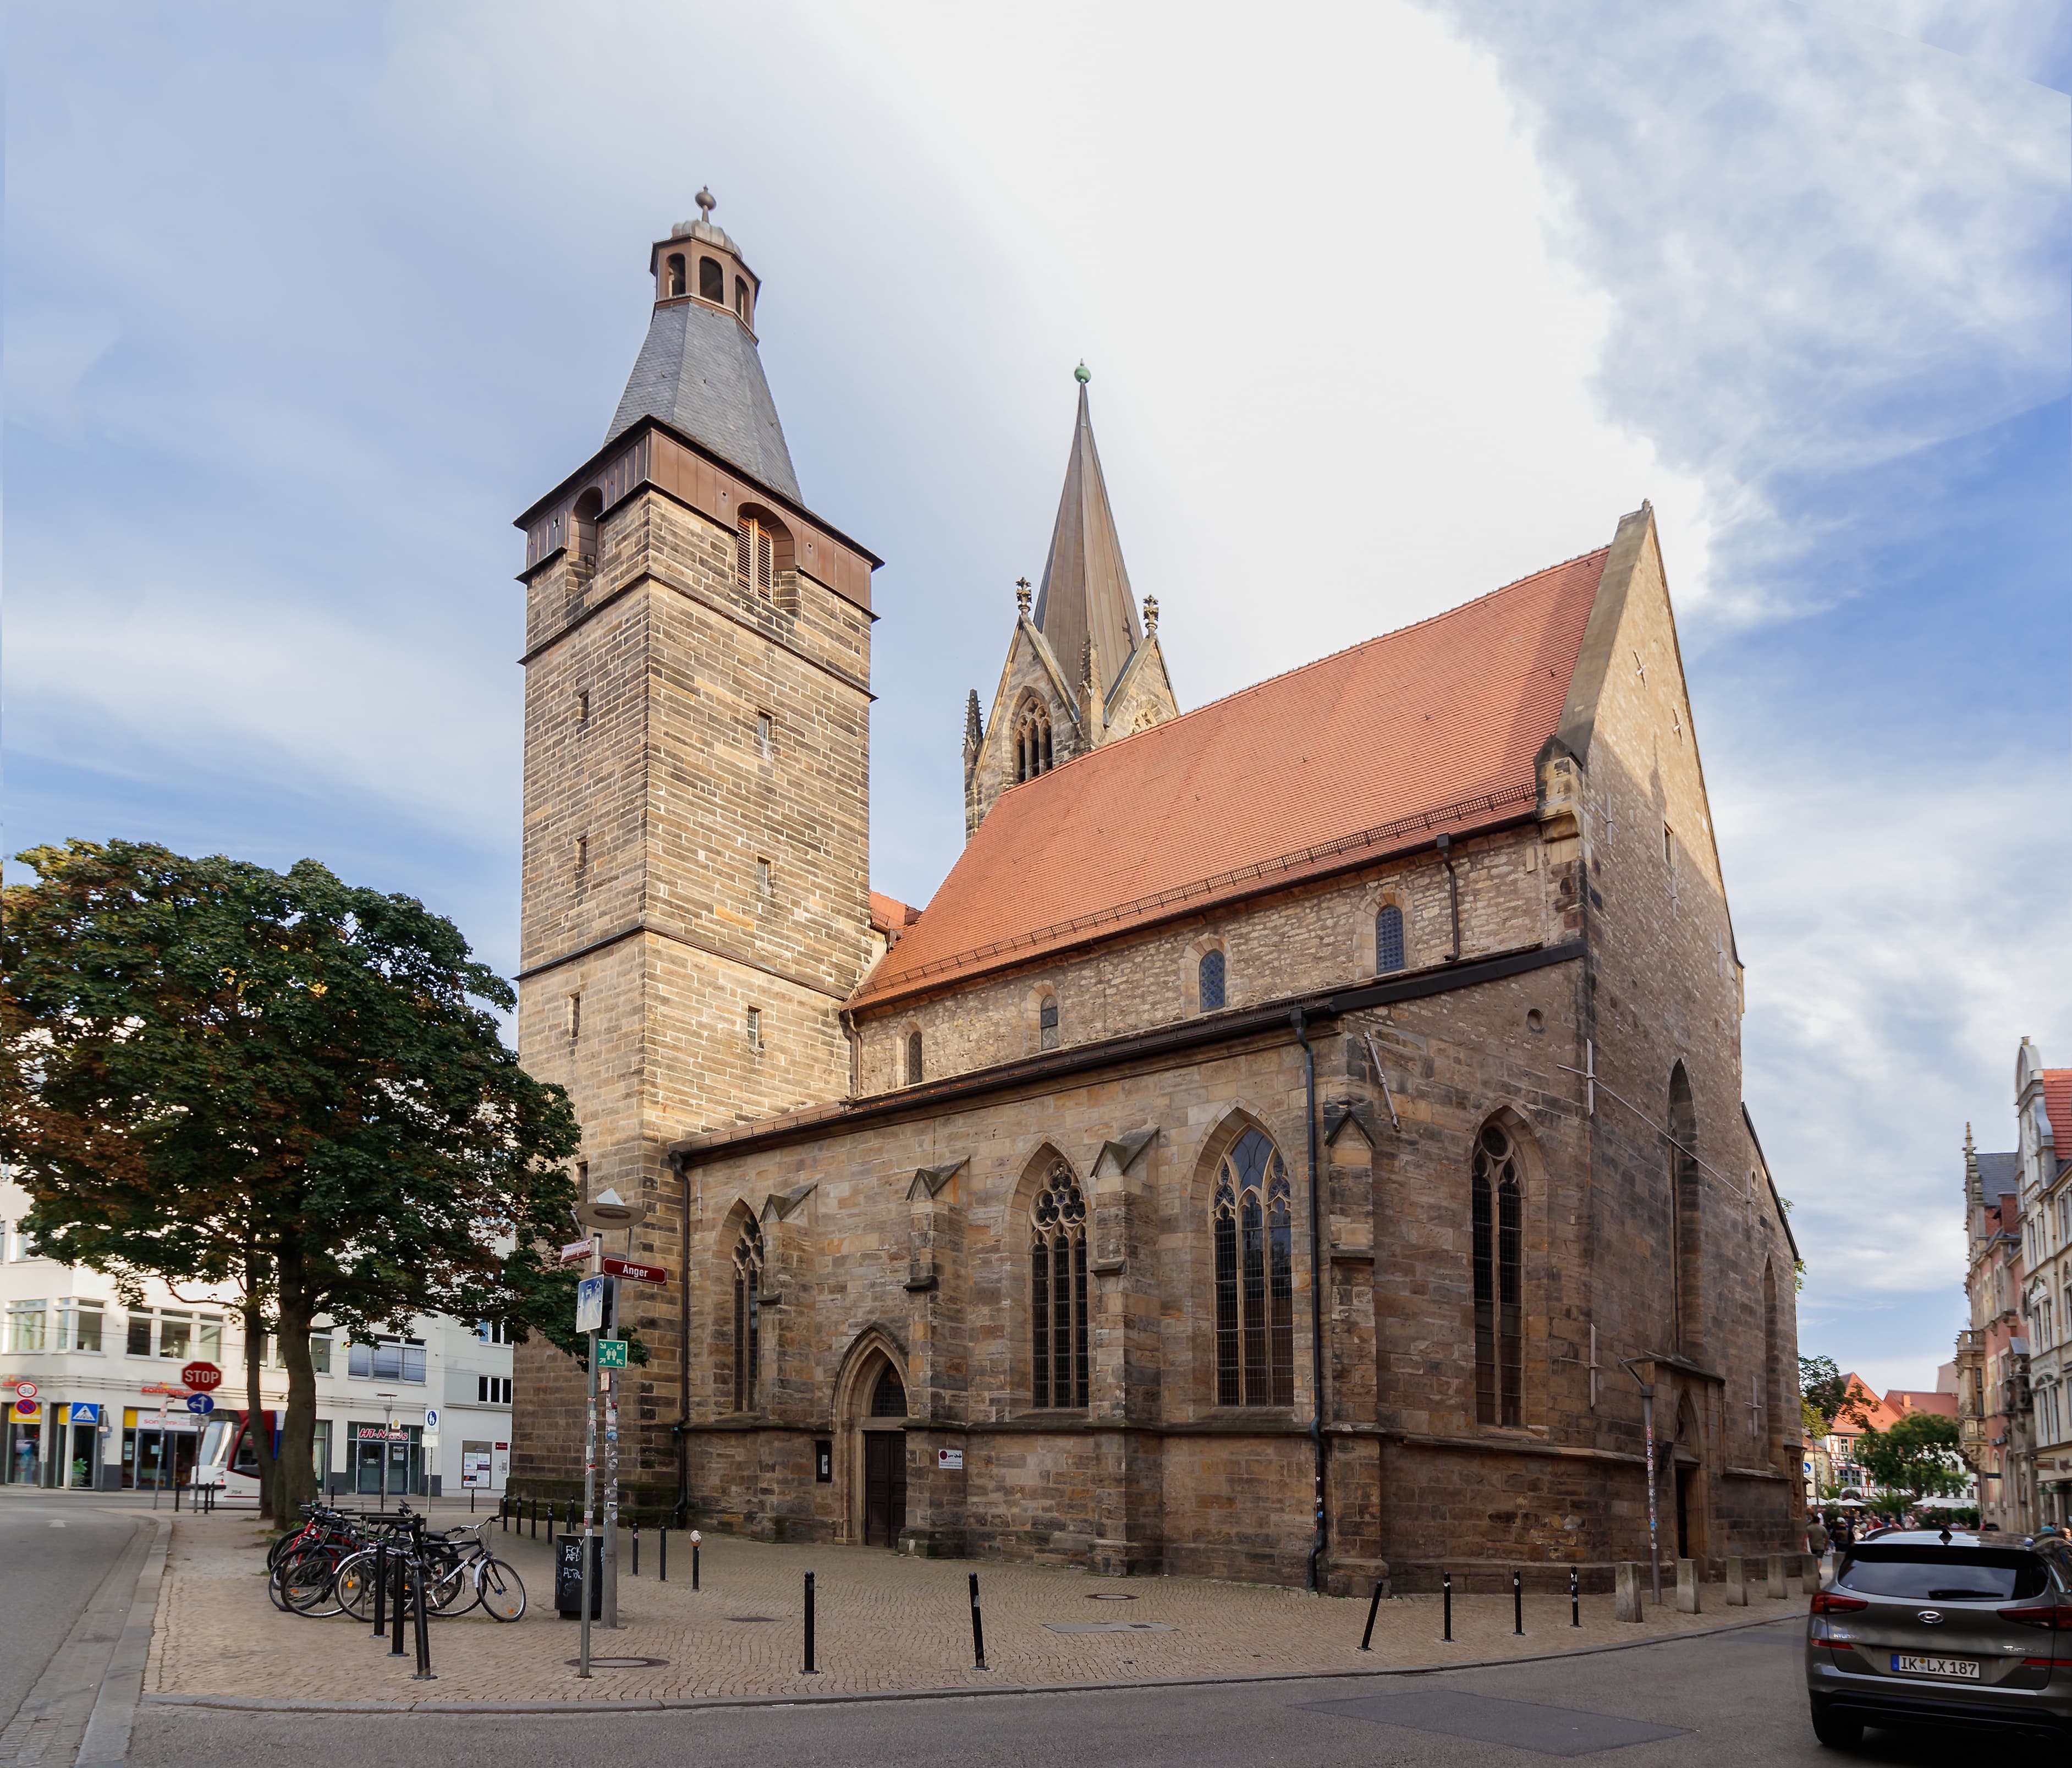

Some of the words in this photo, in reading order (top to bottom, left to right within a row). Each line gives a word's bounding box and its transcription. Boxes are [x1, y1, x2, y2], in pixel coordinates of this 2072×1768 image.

[622, 1264, 648, 1278] Anger
[184, 1369, 219, 1383] STOP
[1901, 1657, 1917, 1671] IK
[1927, 1659, 1946, 1673] LX
[1949, 1661, 1977, 1676] 187
